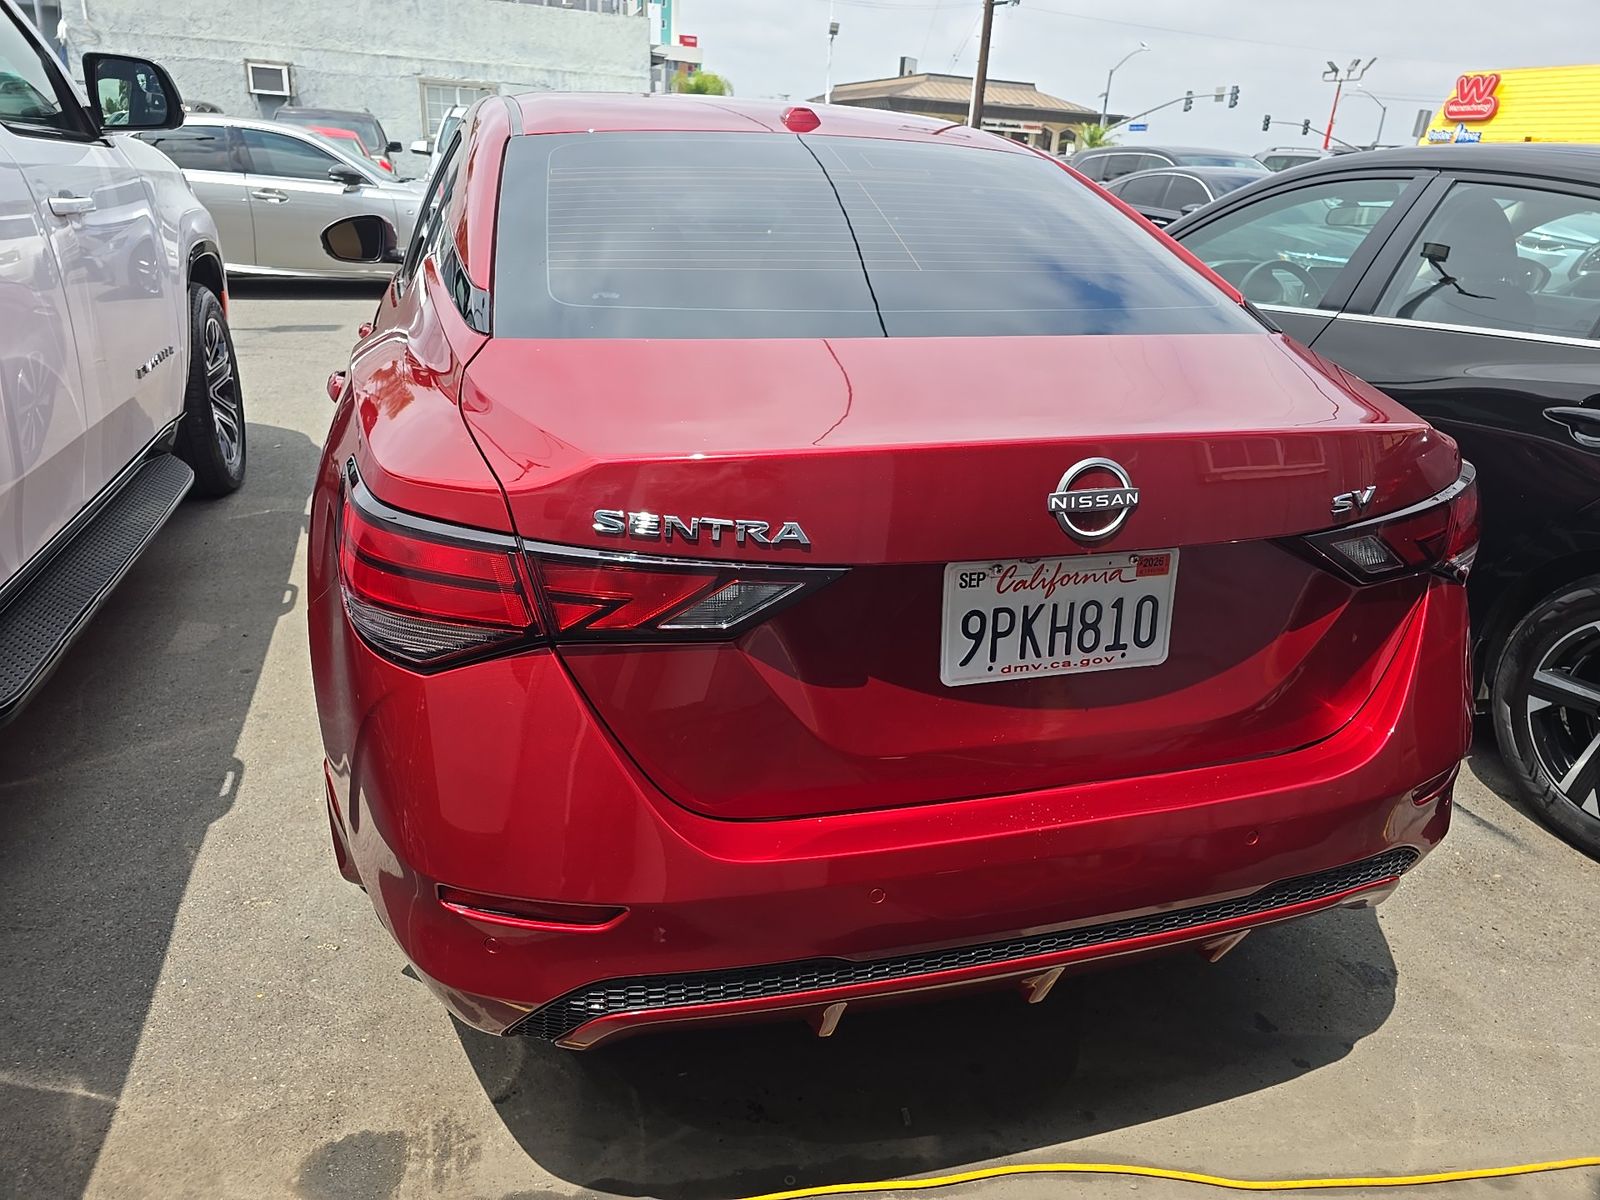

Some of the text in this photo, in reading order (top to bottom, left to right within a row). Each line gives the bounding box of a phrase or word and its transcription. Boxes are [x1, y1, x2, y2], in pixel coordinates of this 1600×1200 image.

[1051, 492, 1139, 509] NISSAN
[1330, 485, 1377, 513] SV
[592, 509, 811, 544] SENTRA
[958, 571, 987, 589] SEP
[996, 562, 1138, 599] California
[958, 594, 1160, 667] 9PKH810
[1000, 655, 1116, 675] dmv.ca.gov
